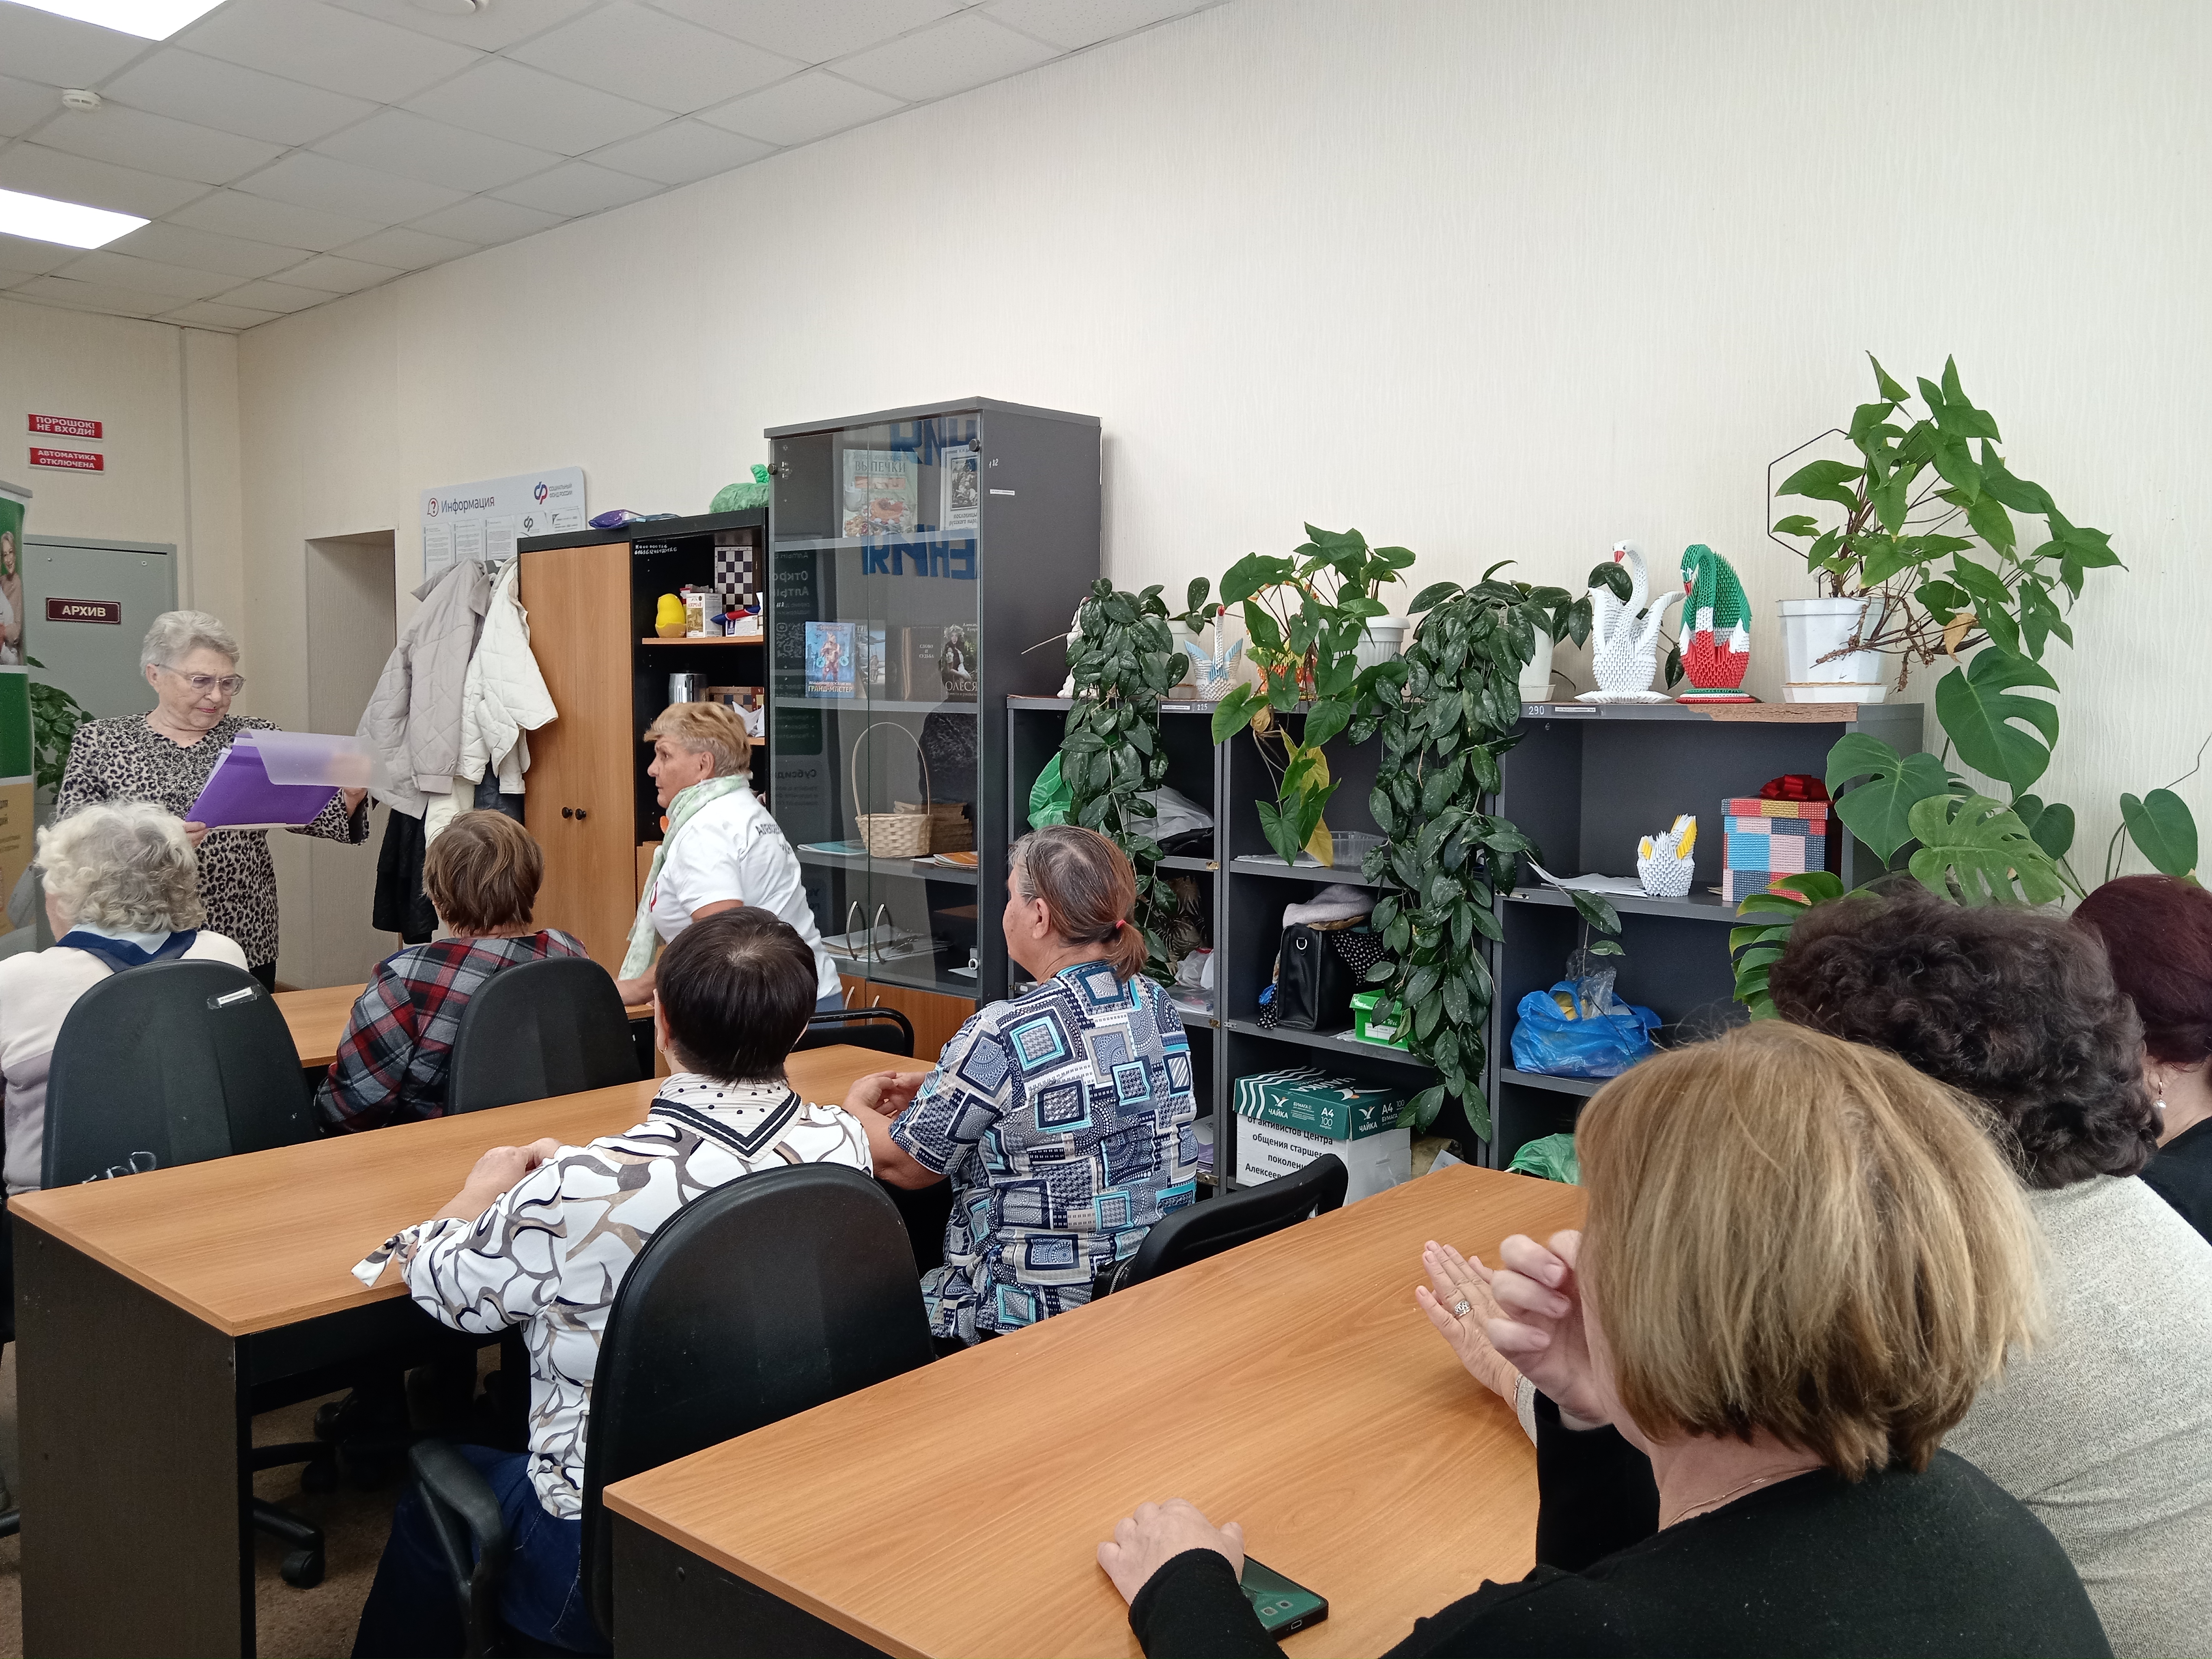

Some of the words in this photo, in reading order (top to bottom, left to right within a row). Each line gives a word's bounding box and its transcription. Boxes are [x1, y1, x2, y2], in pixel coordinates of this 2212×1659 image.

[36, 417, 95, 429] ПОРОШОК!
[55, 425, 95, 436] ВХОДИ!
[38, 450, 96, 461] АВТОМАТИКА
[40, 458, 95, 468] ОТКЛЮЧЕНА
[441, 496, 495, 515] Информация
[62, 606, 106, 617] АРХИВ
[945, 681, 978, 692] ОЛЕСЯ
[1528, 705, 1545, 715] 290
[1268, 1108, 1289, 1119] ЧАЙКА
[1321, 1107, 1334, 1117] A4
[1381, 1103, 1393, 1115] A4
[1321, 1116, 1333, 1127] 100
[1382, 1113, 1398, 1122] БУМАГА
[1258, 1119, 1301, 1136] активистов
[1304, 1130, 1333, 1145] Центра
[1359, 1121, 1378, 1132] ЧАЙКА
[1253, 1134, 1288, 1150] общения
